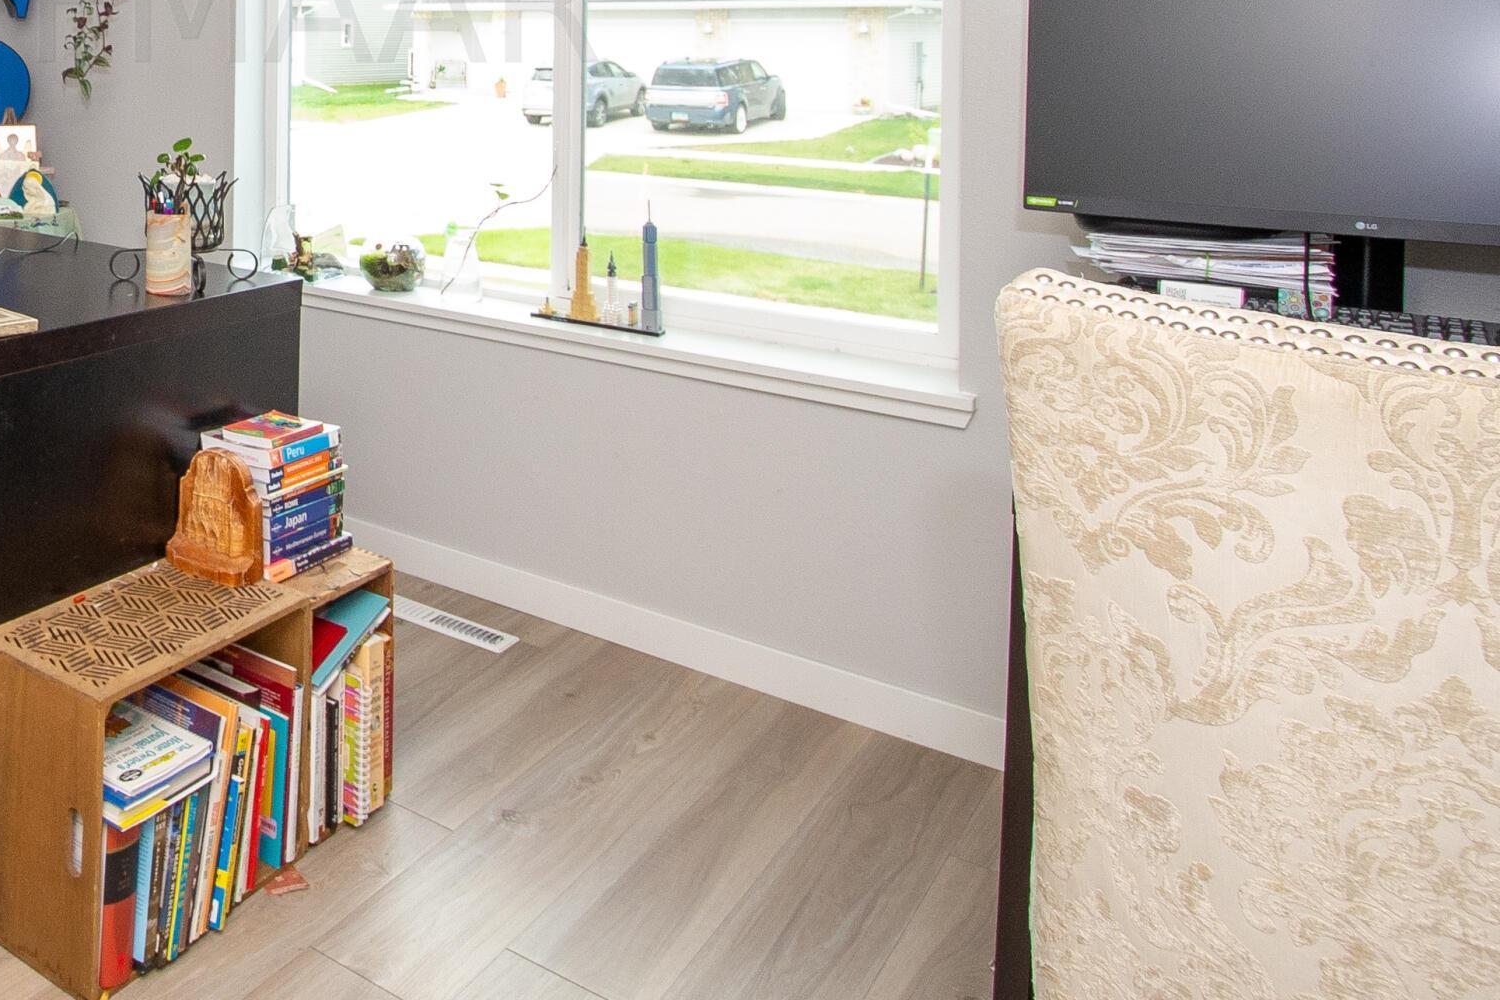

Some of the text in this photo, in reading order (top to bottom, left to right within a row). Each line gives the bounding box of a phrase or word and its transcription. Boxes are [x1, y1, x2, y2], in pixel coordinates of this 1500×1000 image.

[1366, 222, 1378, 231] LG
[286, 446, 305, 460] Peru
[285, 512, 307, 529] Japan
